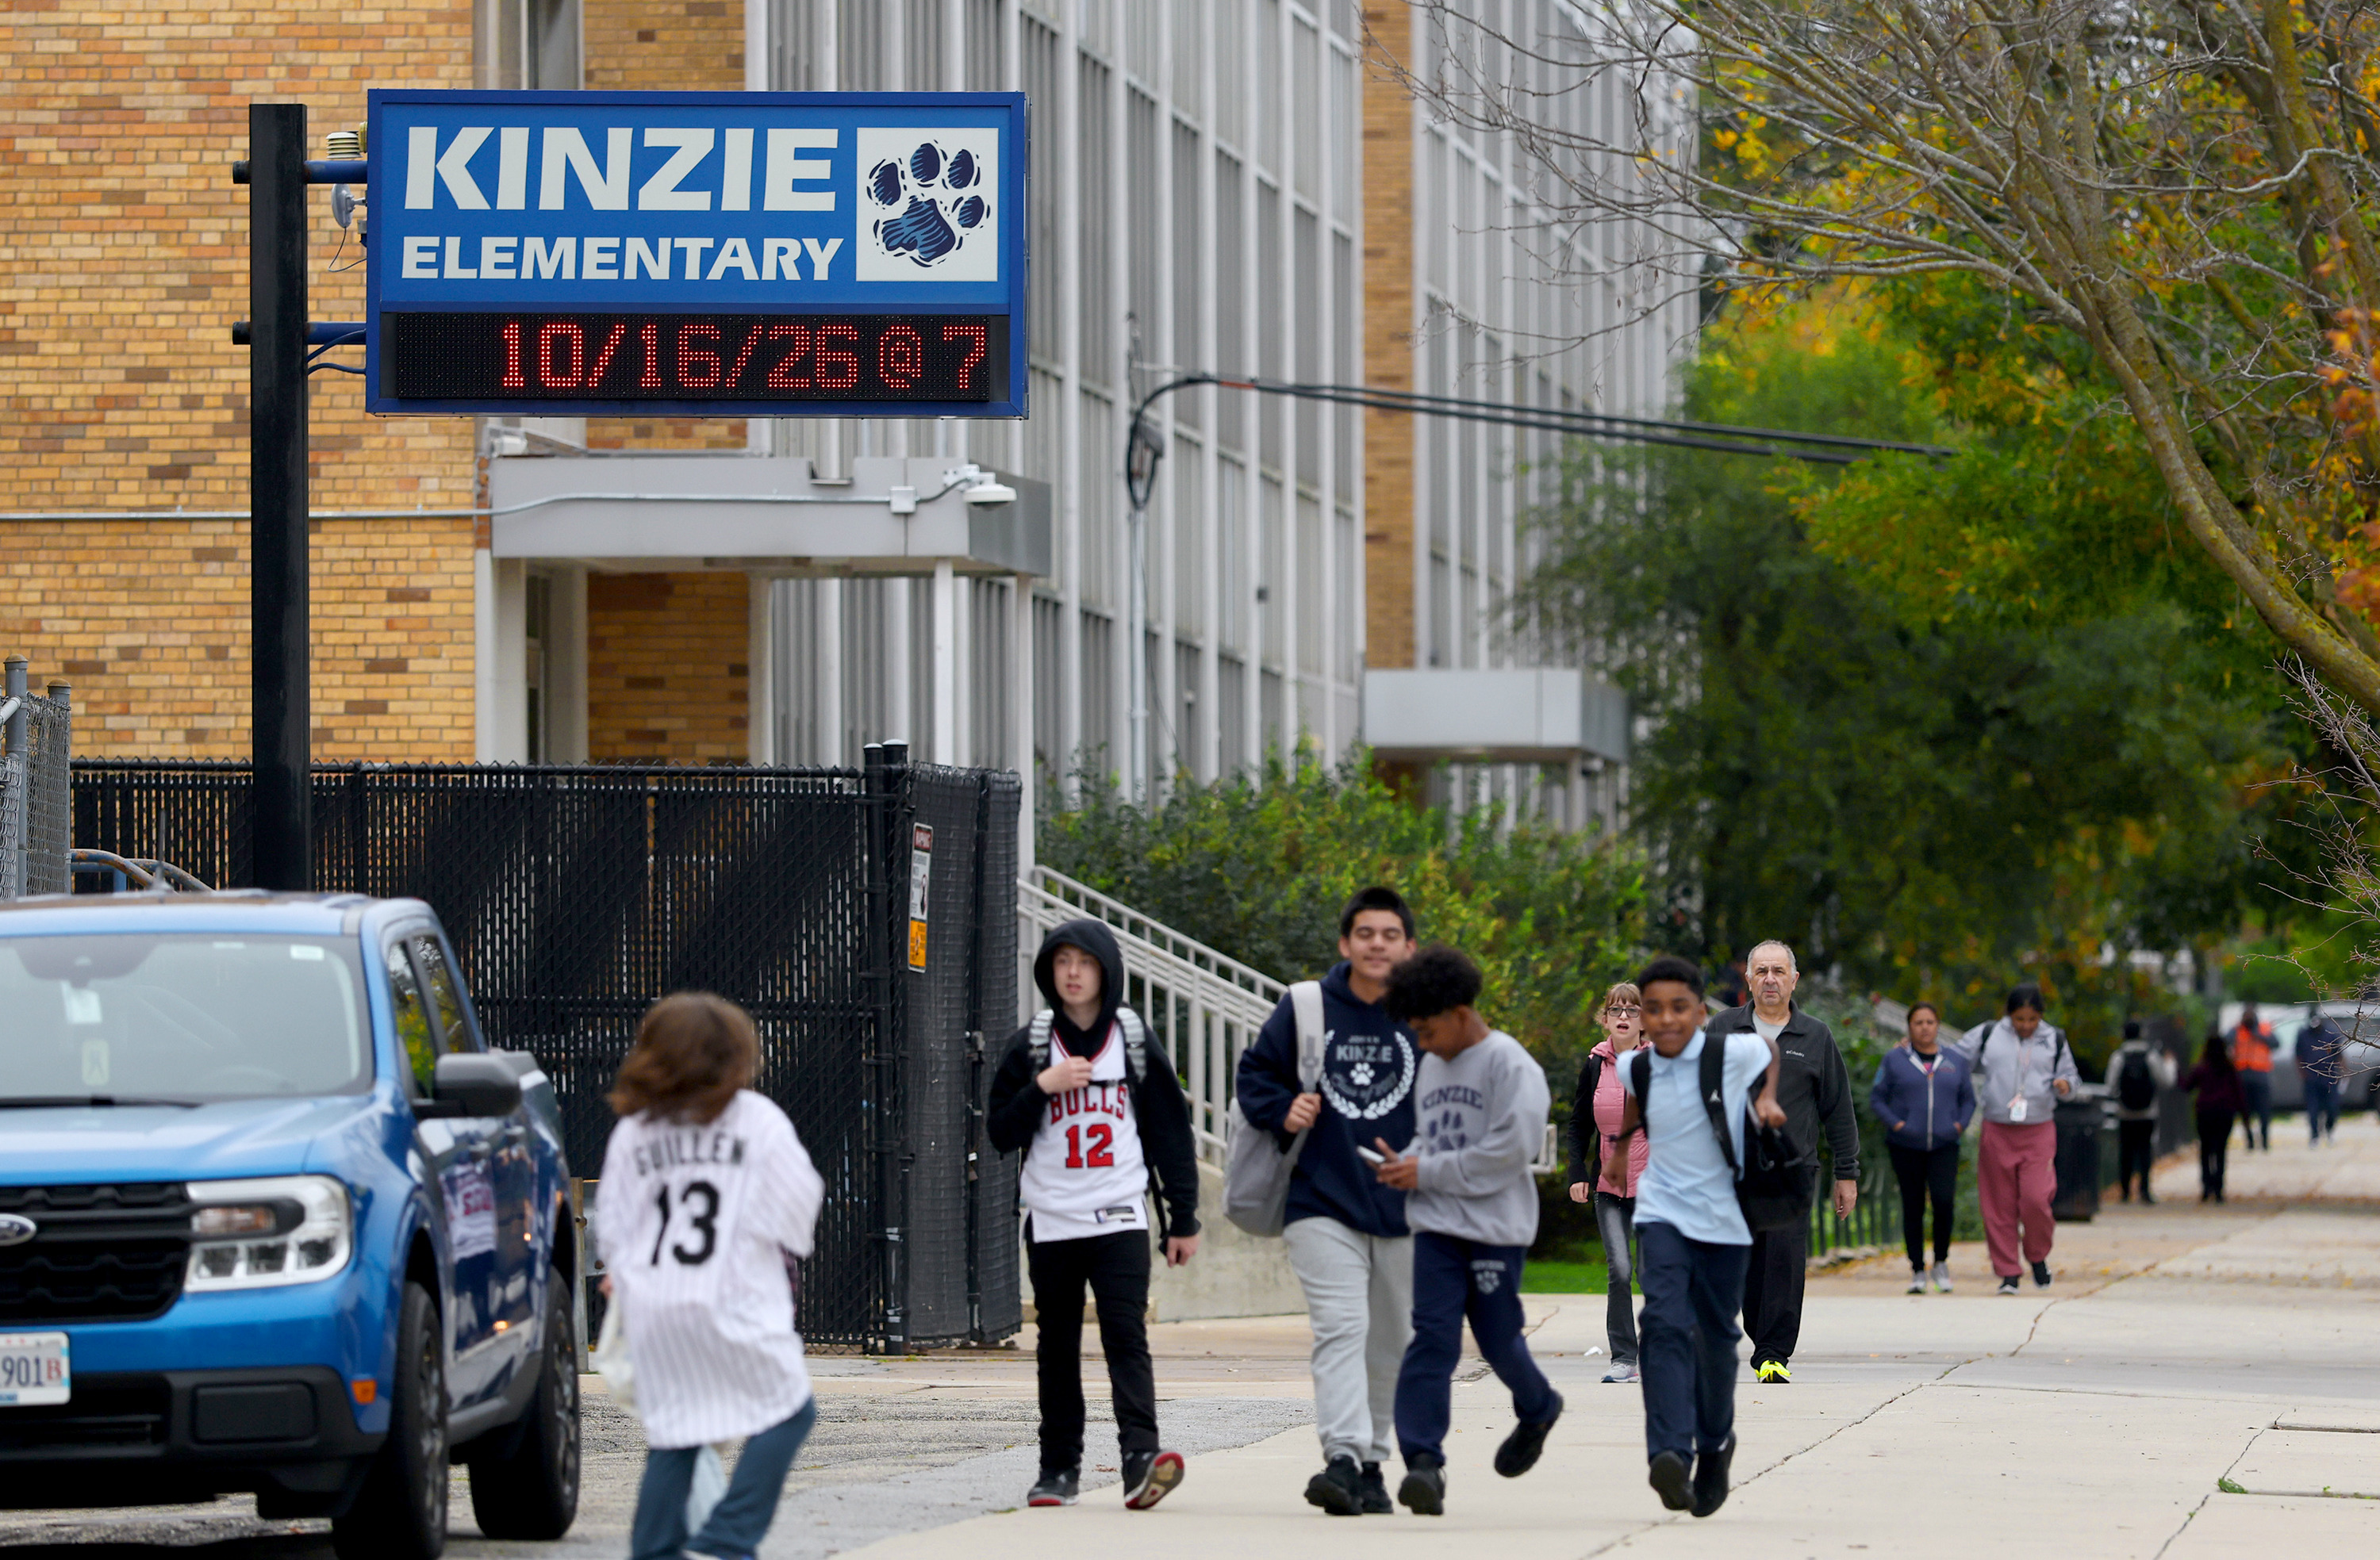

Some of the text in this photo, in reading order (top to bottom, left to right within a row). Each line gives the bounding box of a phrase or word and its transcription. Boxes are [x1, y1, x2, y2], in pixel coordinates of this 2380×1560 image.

[405, 126, 839, 212] KINZIE
[401, 236, 844, 282] ELEMENTARY
[502, 323, 985, 389] 10/16/26 @ 7
[1050, 1085, 1127, 1125] BULLS
[1065, 1123, 1114, 1168] 12
[651, 1180, 720, 1267] 13
